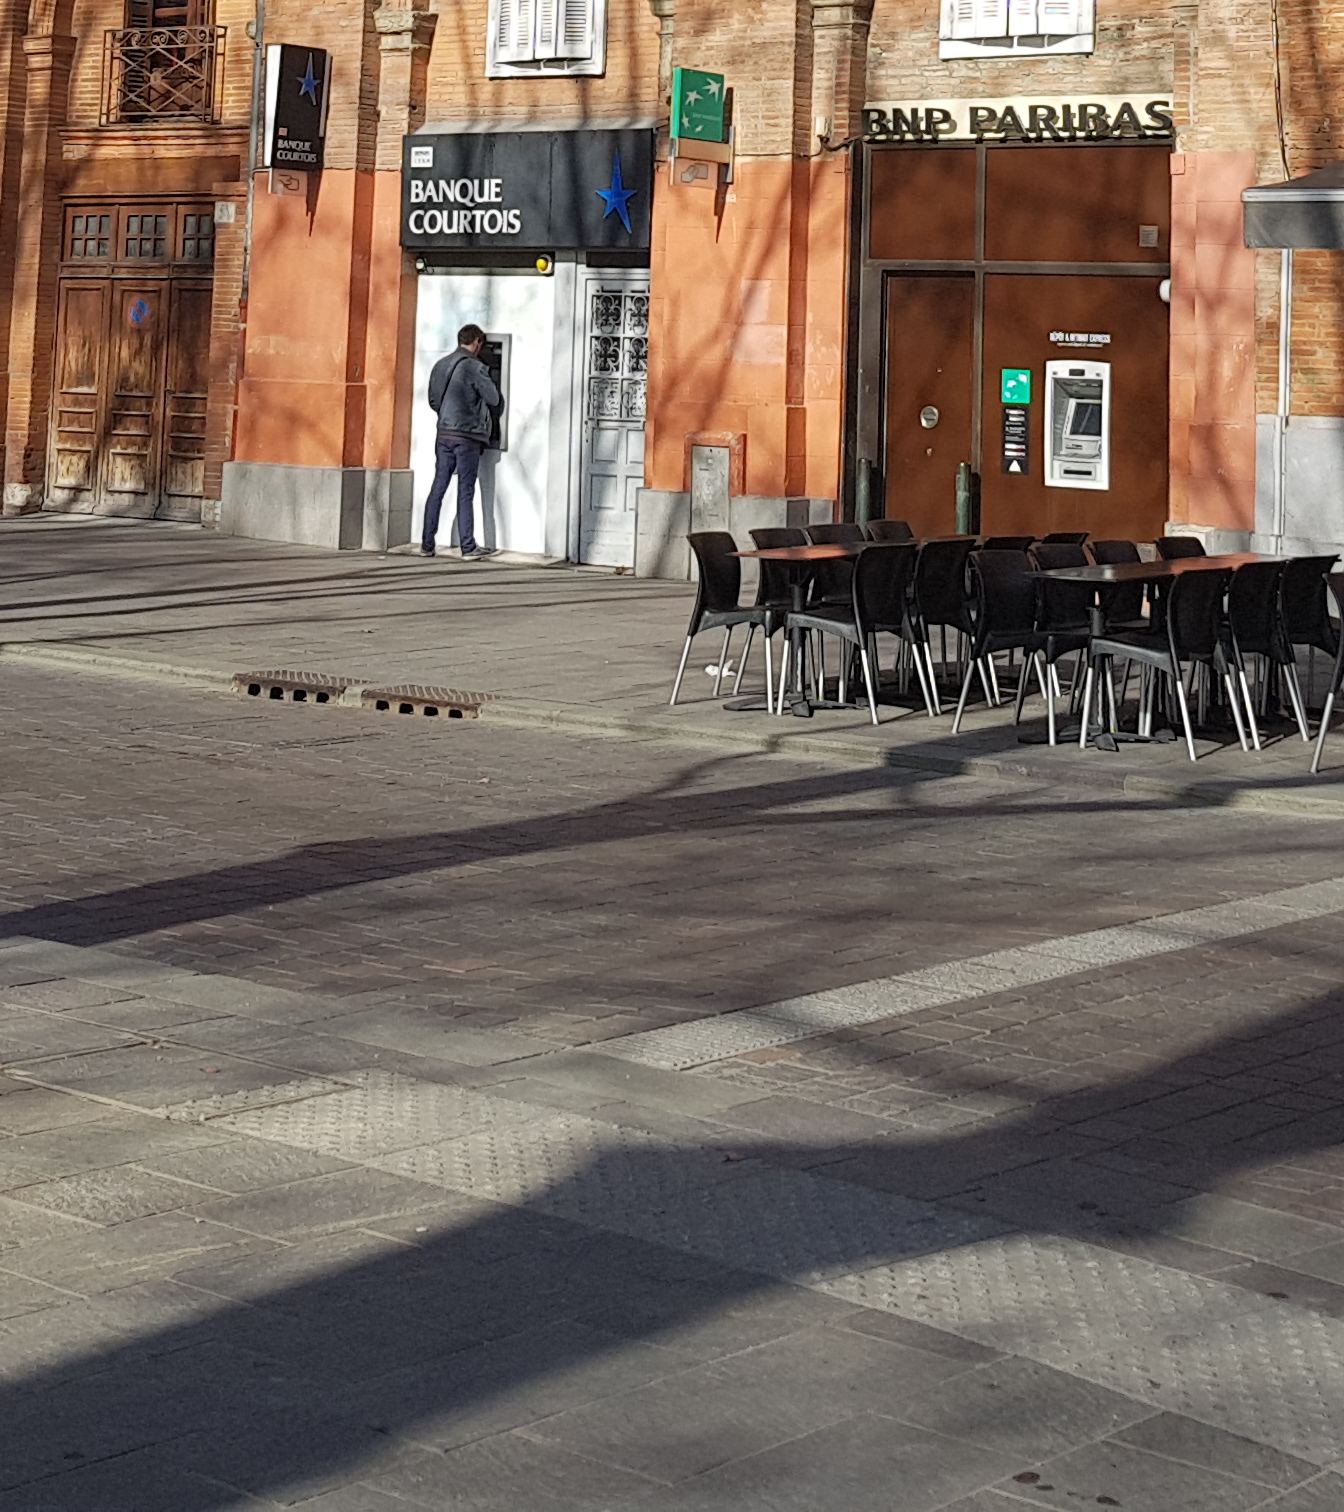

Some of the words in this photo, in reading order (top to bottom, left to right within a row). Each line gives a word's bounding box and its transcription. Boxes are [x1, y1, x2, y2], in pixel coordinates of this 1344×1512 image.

[862, 107, 954, 136] BNP
[969, 100, 1173, 136] PARIBAS
[277, 139, 312, 151] BANQUE
[410, 178, 503, 207] BANQUE
[408, 209, 522, 234] COURTOIS
